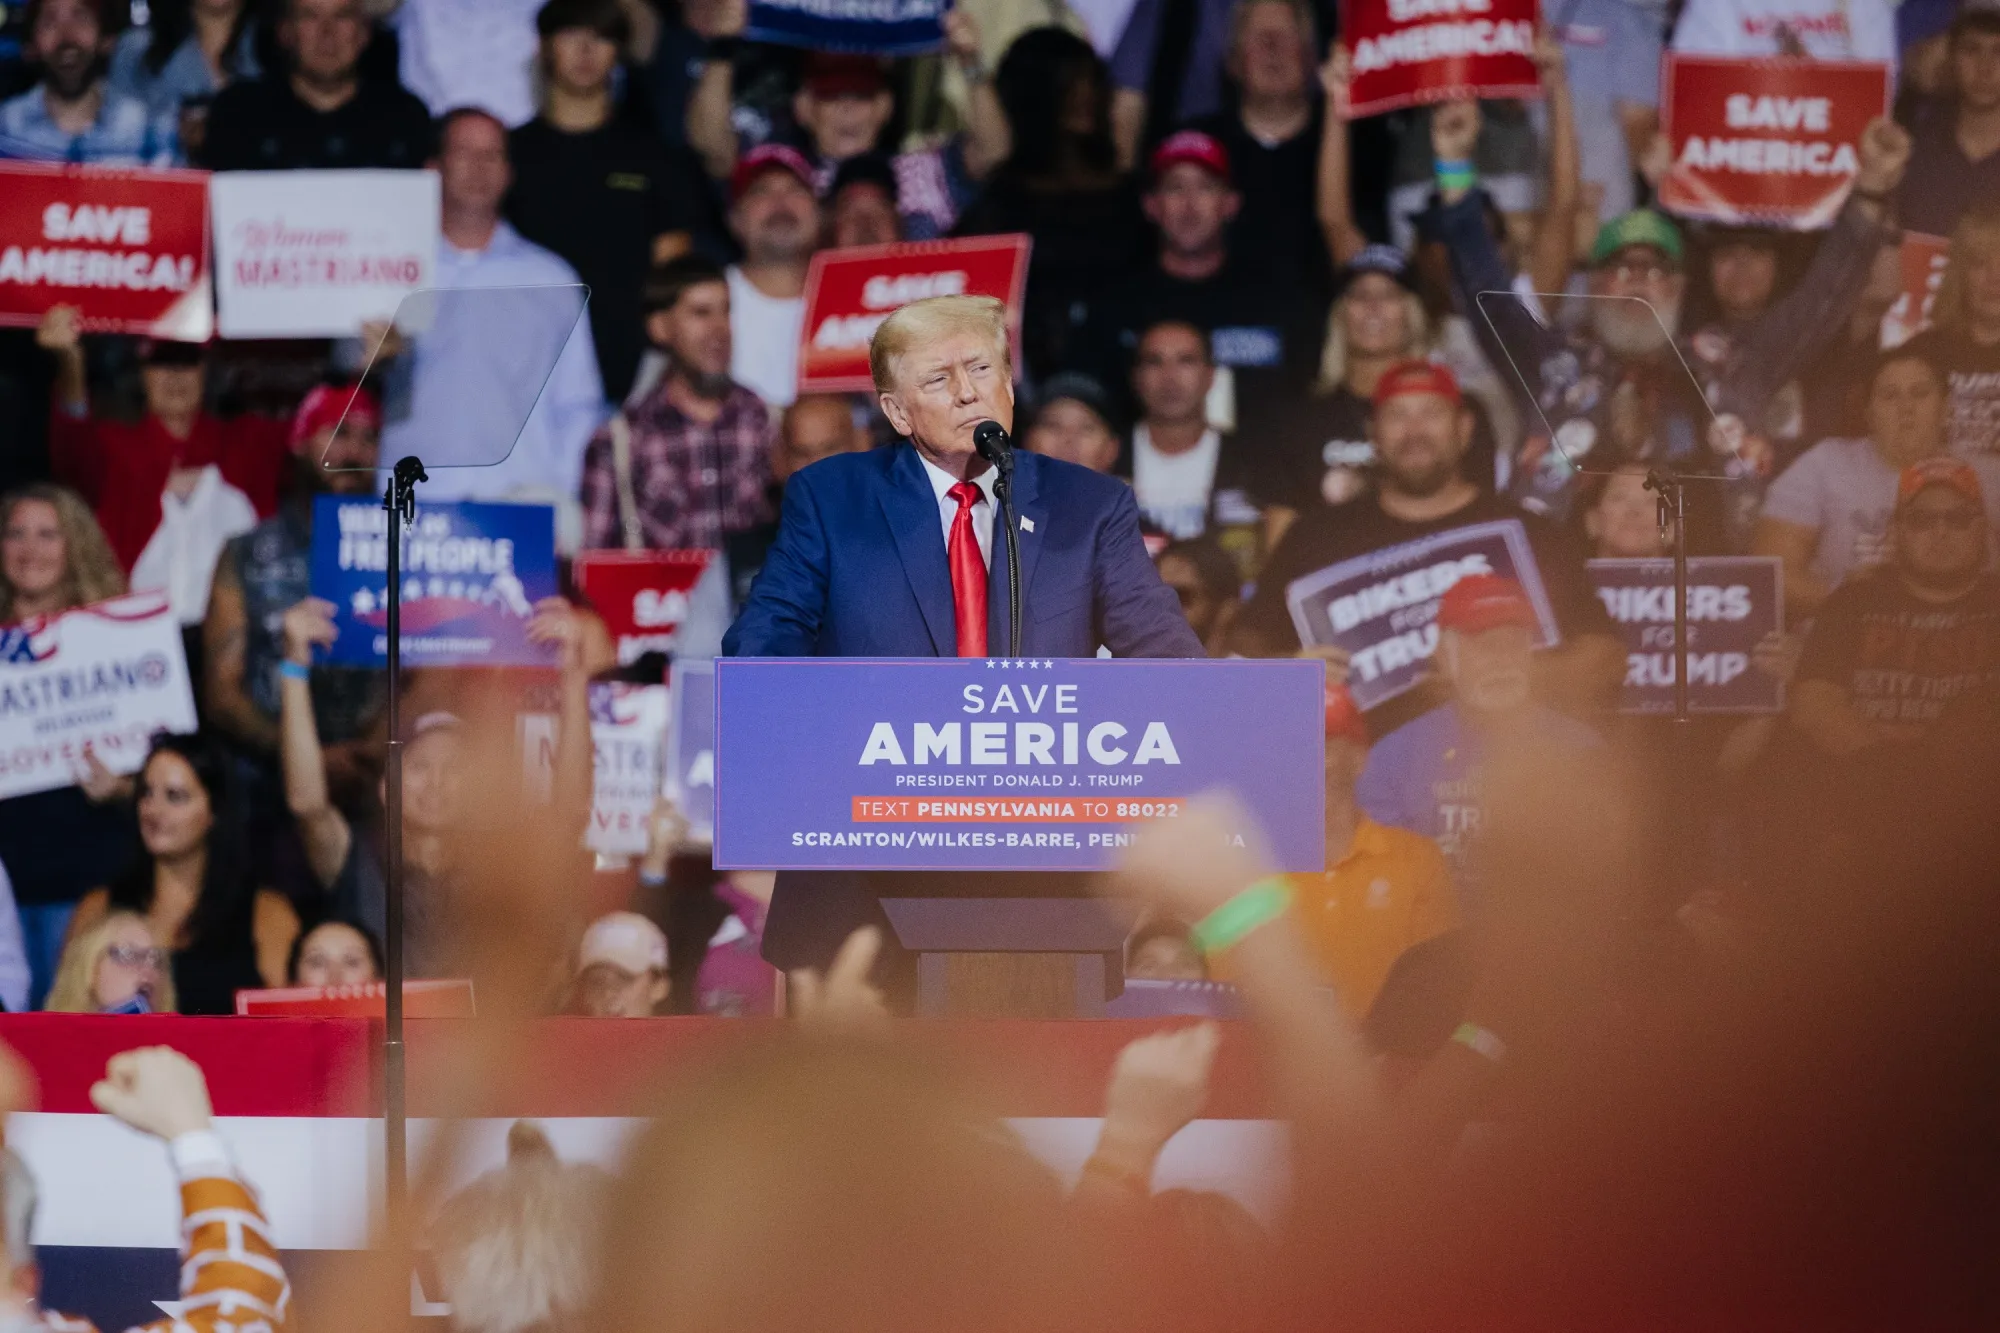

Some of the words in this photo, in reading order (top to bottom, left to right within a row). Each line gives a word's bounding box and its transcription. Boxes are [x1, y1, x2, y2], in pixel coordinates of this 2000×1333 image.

[1354, 18, 1533, 72] AMERICA!
[1725, 94, 1830, 132] SAVE
[43, 202, 151, 244] SAVE
[0, 246, 194, 292] AMERICA!
[1623, 653, 1748, 687] RUMP
[962, 684, 1078, 714] SAVE
[858, 721, 1181, 766] AMERICA
[895, 774, 987, 788] PRESIDENT
[993, 774, 1063, 788] DONALD
[1068, 774, 1082, 788] J.
[1087, 774, 1144, 788] TRUMP
[859, 801, 910, 817] TEXT
[917, 801, 1075, 818] PENNSYLVANIA
[1082, 802, 1109, 818] TO
[1116, 802, 1179, 818] 88022
[791, 830, 1081, 849] SCRANTON/WILKES-BARRE,
